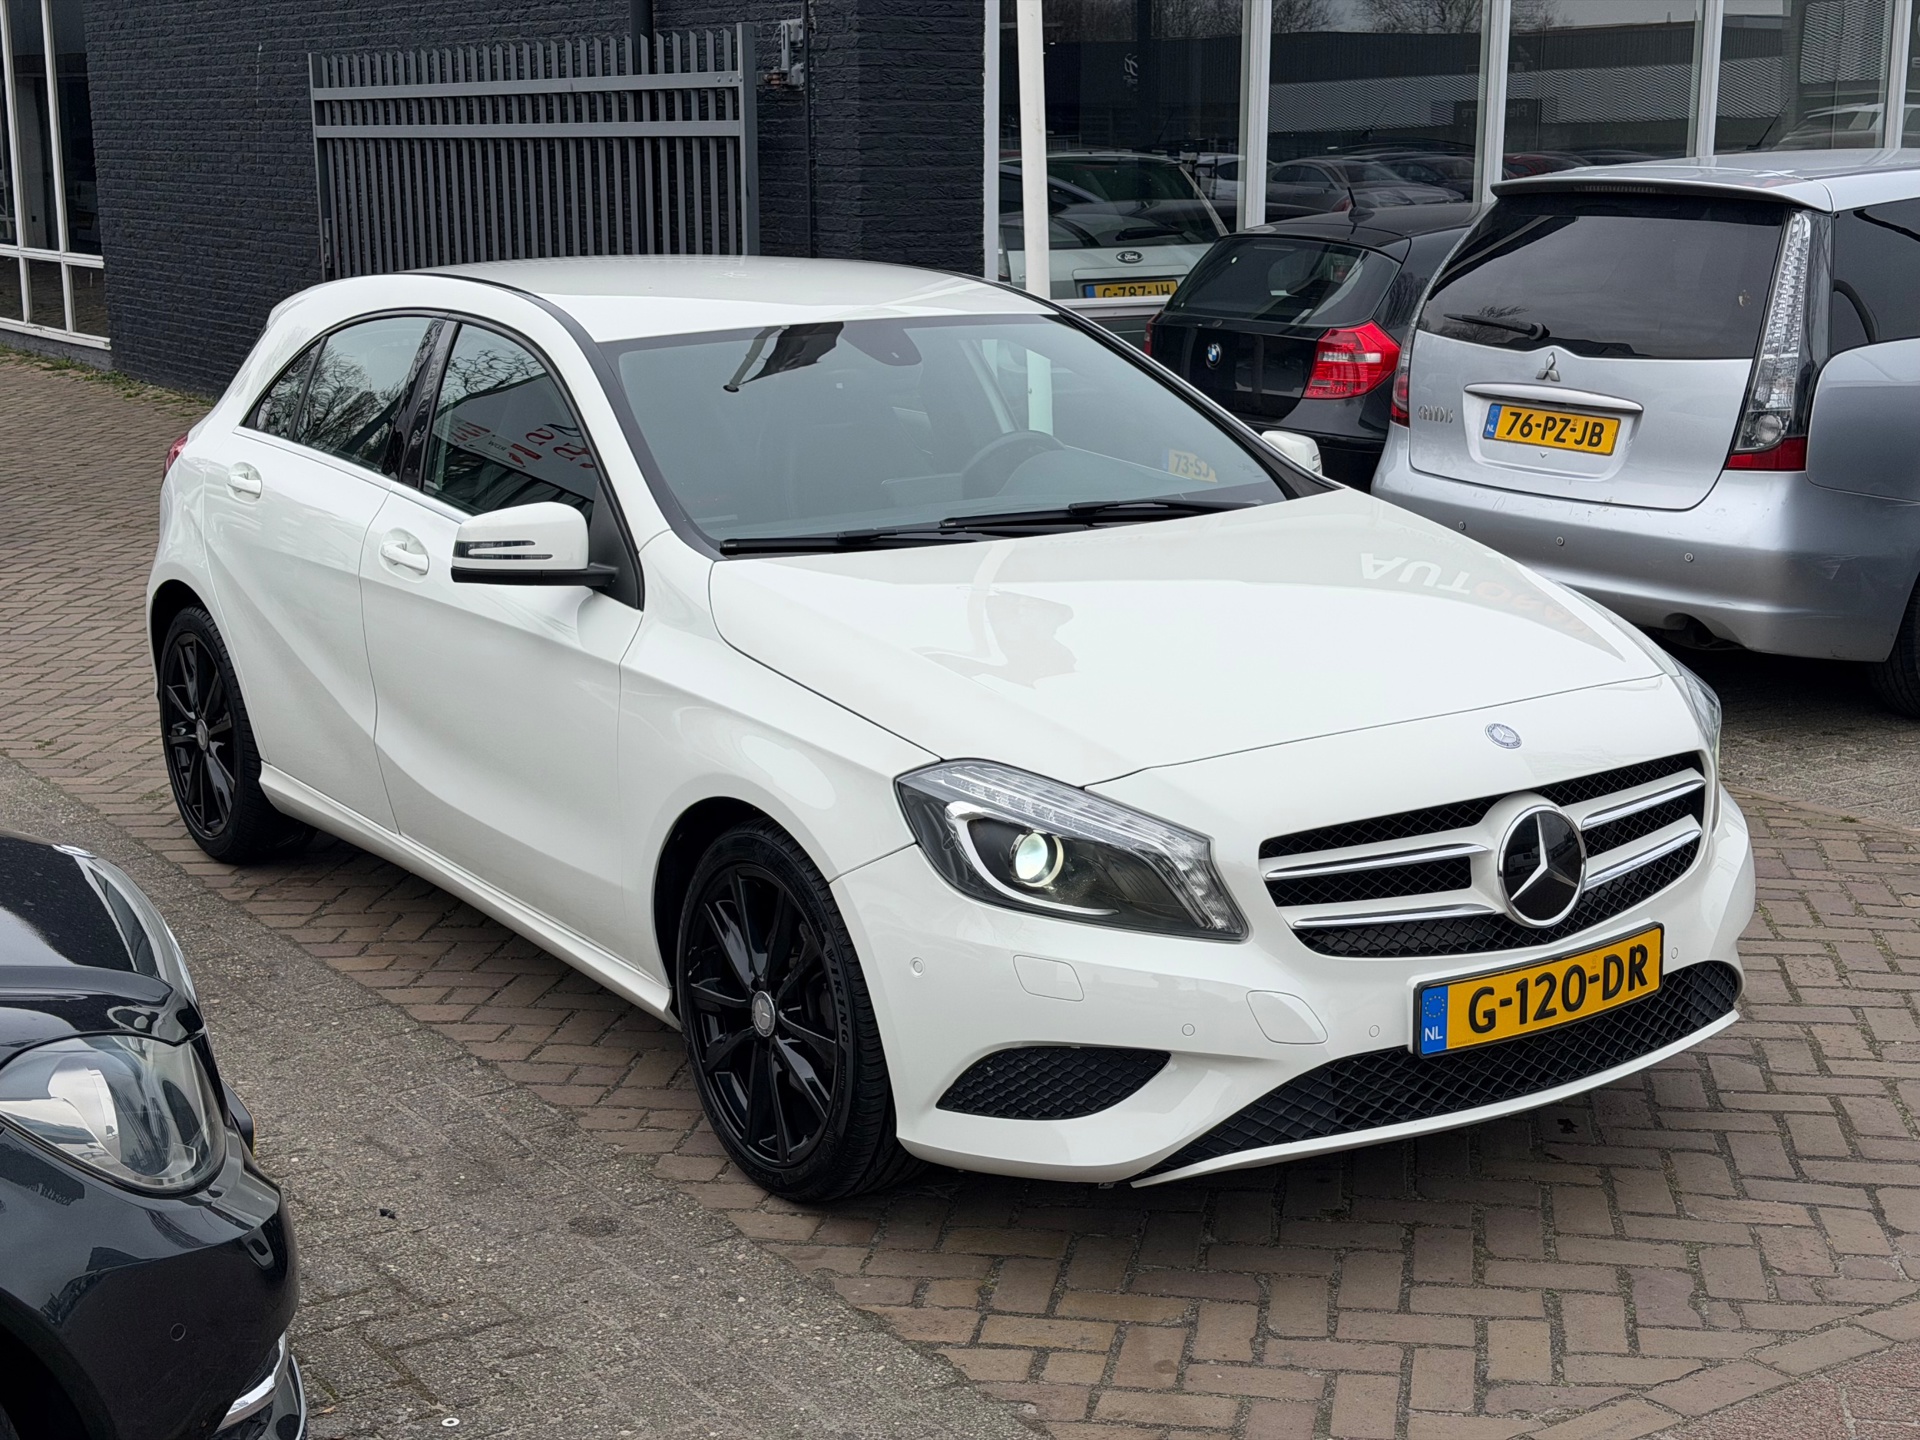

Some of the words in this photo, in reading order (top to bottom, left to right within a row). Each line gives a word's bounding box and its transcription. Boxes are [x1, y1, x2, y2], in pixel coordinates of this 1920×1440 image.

[1486, 424, 1495, 433] NL
[1505, 411, 1605, 448] 76-PZ-JB
[825, 948, 850, 1044] VIKING
[1468, 943, 1649, 1034] G-120-DR
[1424, 1025, 1444, 1042] NL
